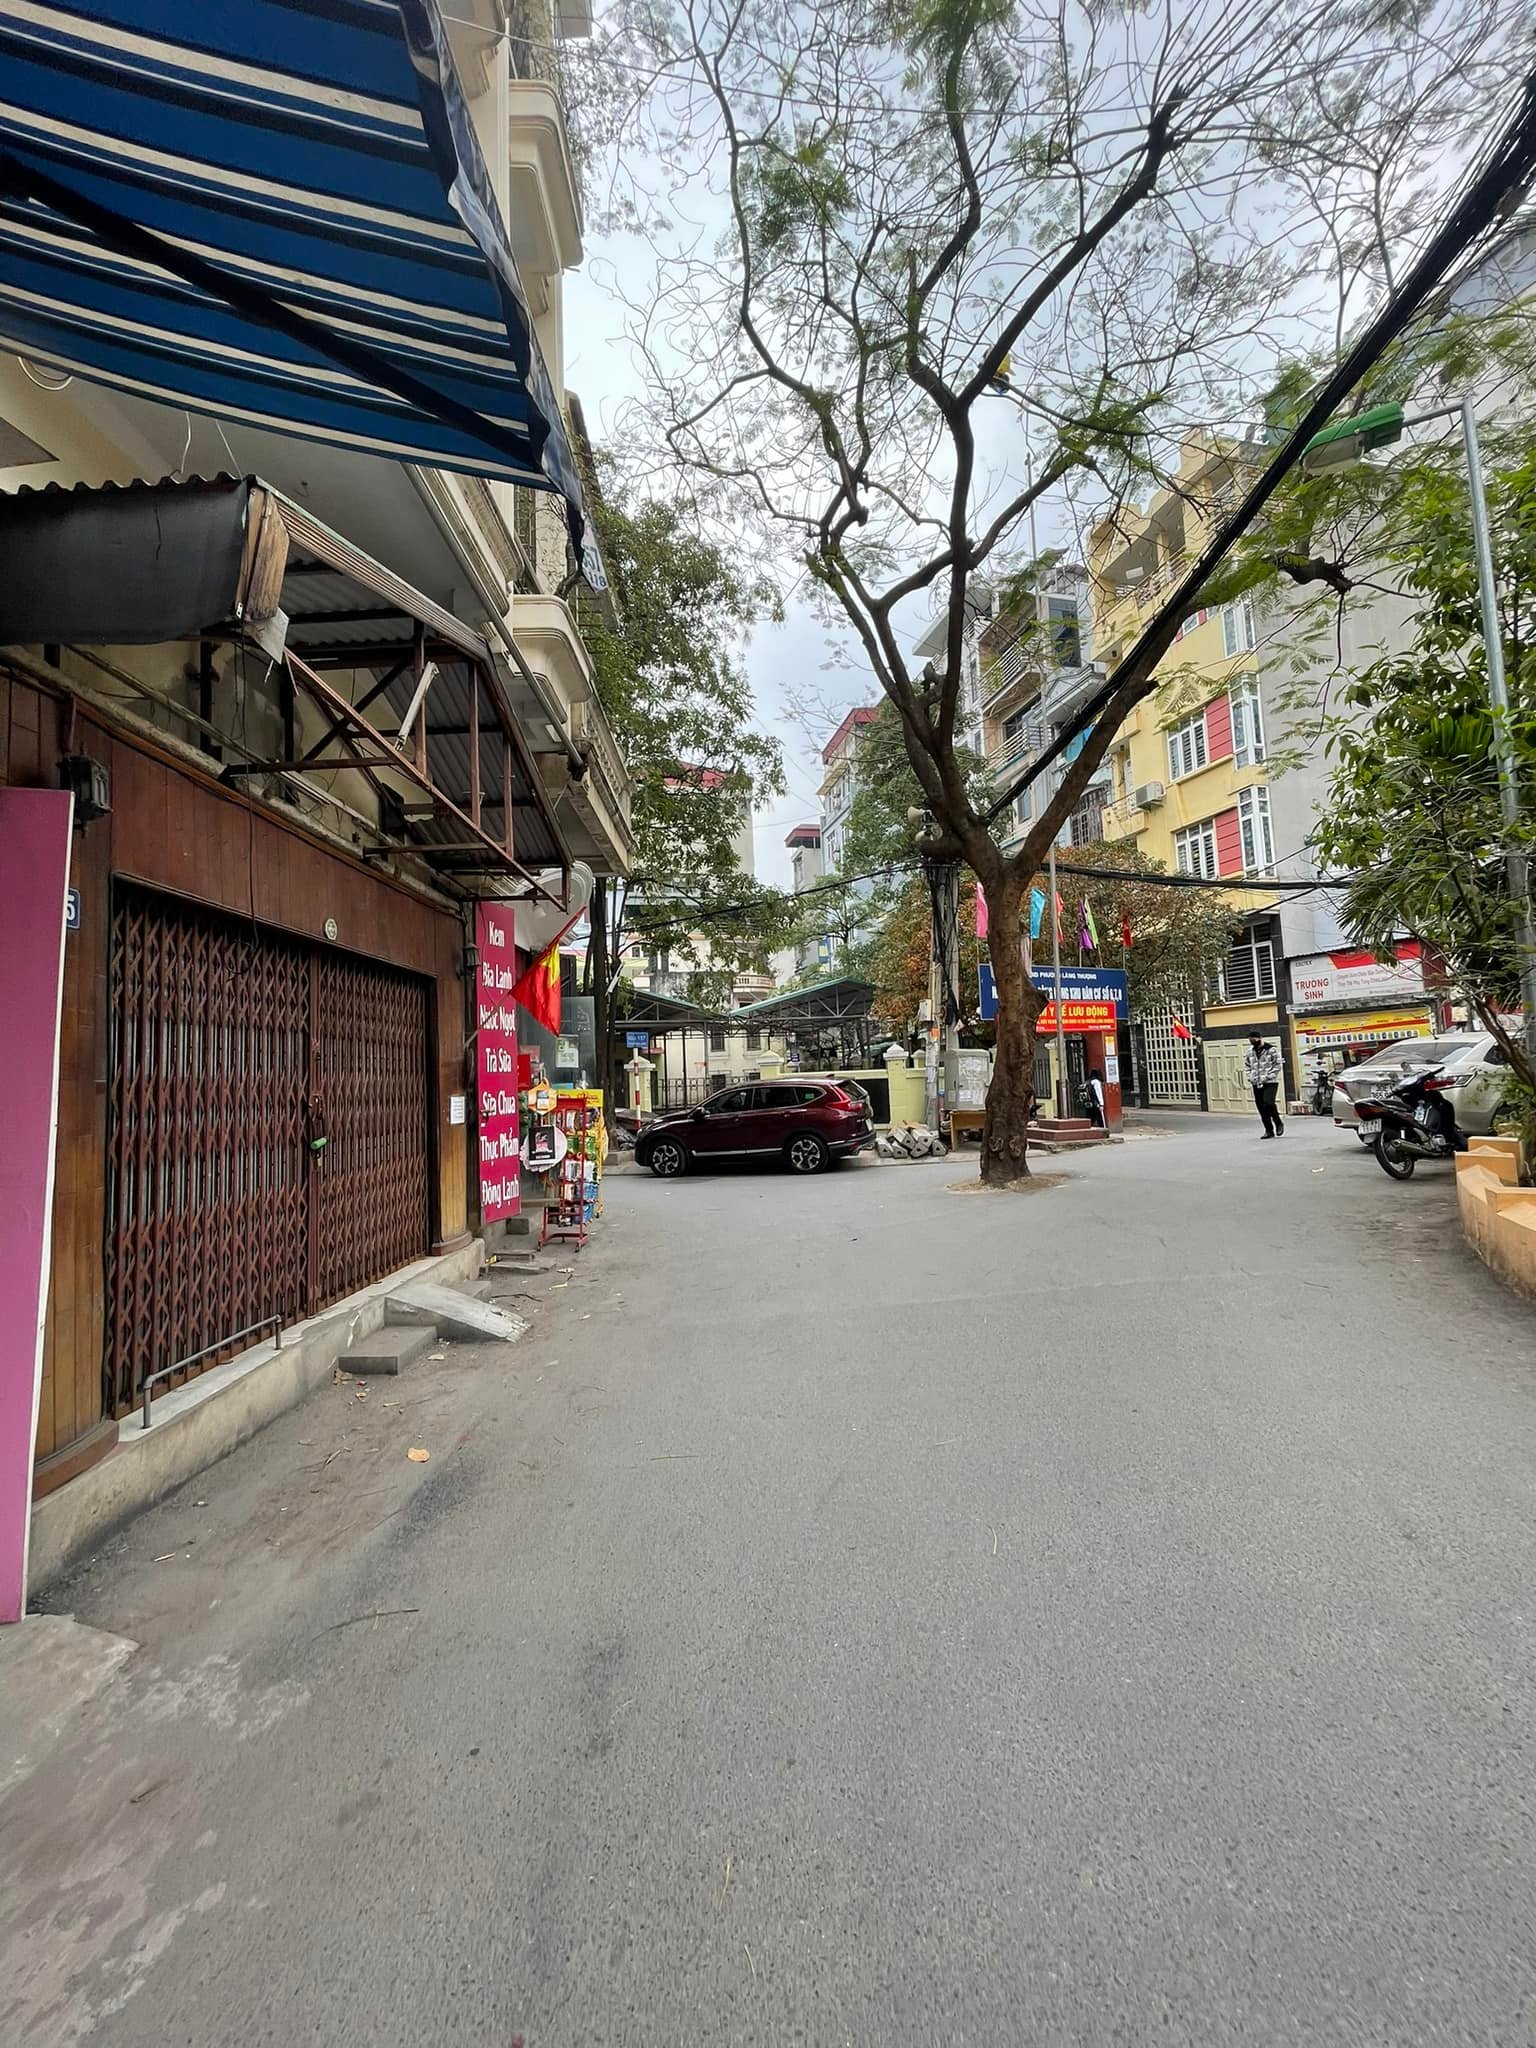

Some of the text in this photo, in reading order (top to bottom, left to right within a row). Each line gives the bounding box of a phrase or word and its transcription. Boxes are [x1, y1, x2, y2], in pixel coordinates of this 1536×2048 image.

[489, 920, 505, 947] Kem
[483, 961, 513, 995] Bia Lạnh
[1304, 990, 1324, 1000] SINH
[499, 1007, 516, 1037] Ngọt
[486, 1048, 512, 1073] Trà Sữa
[498, 1090, 516, 1115] Chua
[480, 1135, 498, 1166] Thực
[499, 1127, 519, 1158] Phẩm
[502, 1174, 520, 1206] Lạnh
